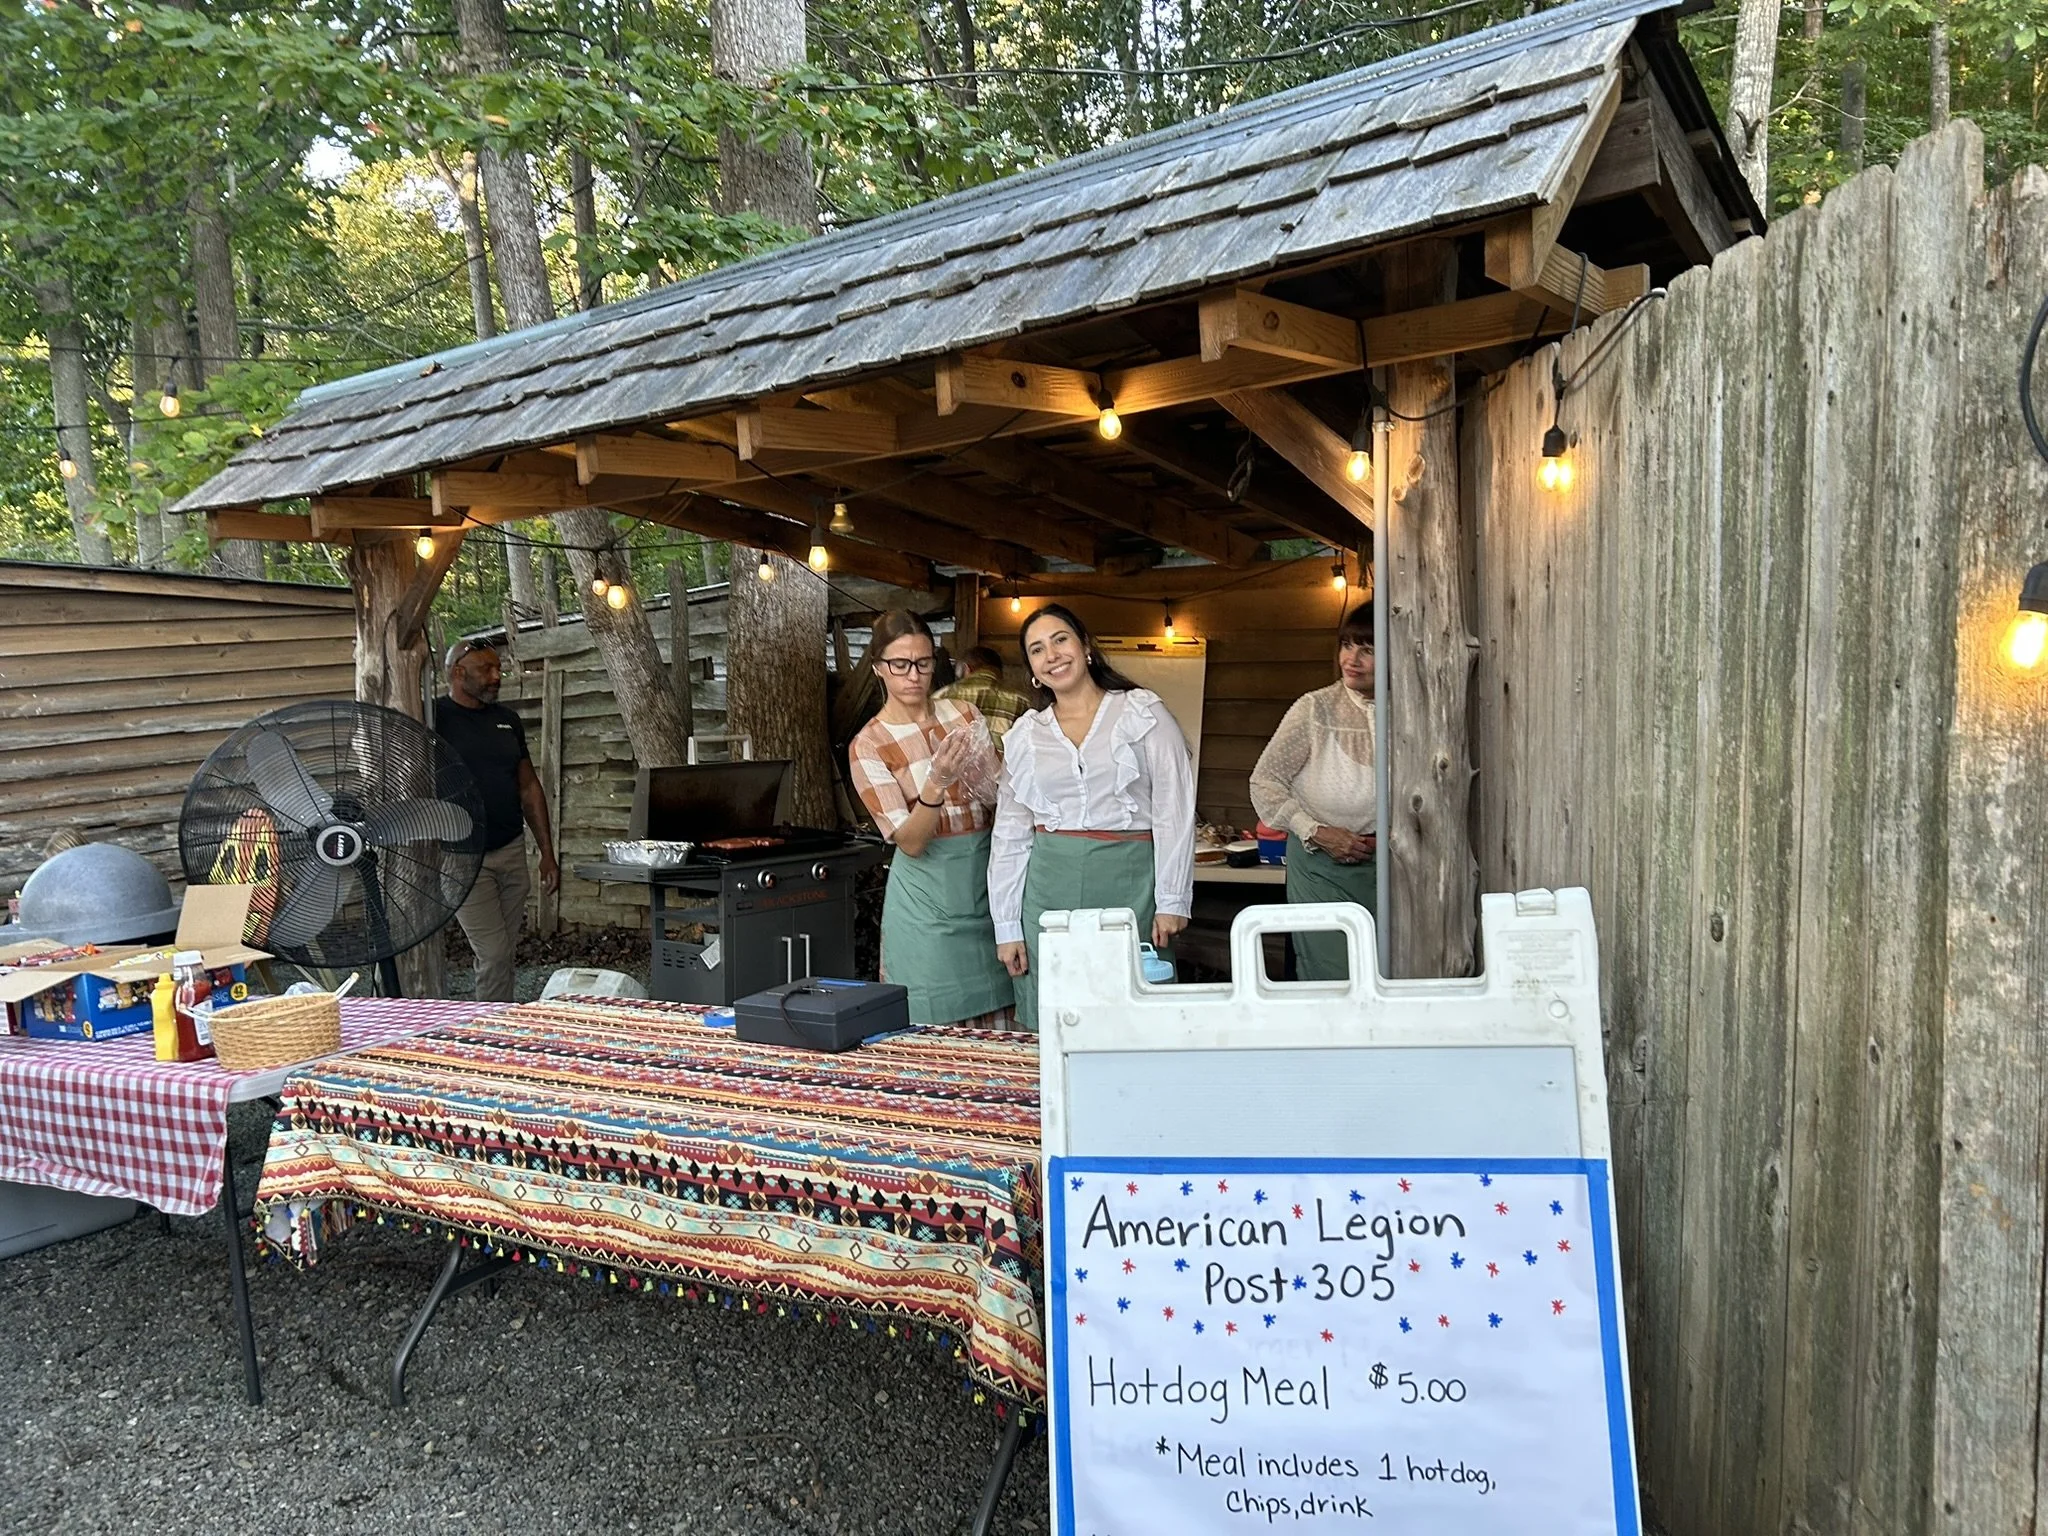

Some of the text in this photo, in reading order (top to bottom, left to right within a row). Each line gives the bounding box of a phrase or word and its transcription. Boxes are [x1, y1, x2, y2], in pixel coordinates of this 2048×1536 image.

[1081, 1194, 1467, 1262] American Legion
[1204, 1261, 1396, 1306] Post 305
[1087, 1354, 1468, 1425] Hotdog Meal $5.00
[1257, 1450, 1361, 1479] includes
[1378, 1452, 1399, 1481] 1
